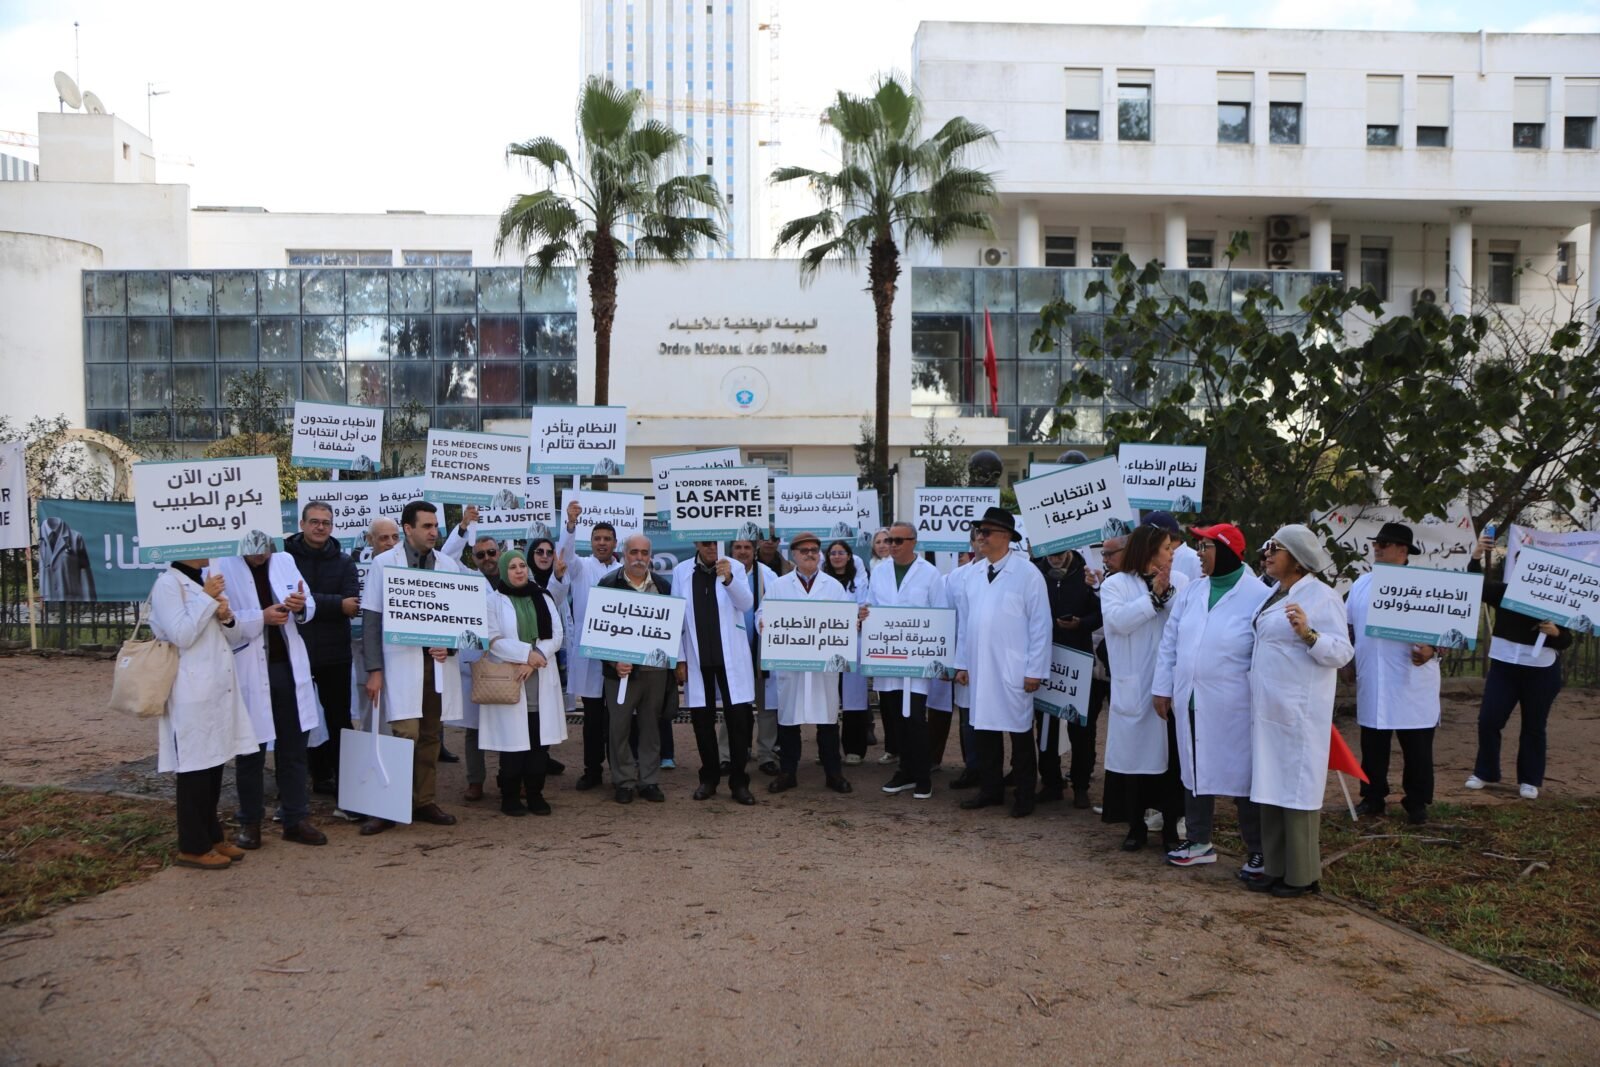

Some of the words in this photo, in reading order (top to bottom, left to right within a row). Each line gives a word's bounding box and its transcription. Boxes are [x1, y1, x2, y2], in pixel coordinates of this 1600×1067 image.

[659, 342, 691, 355] Ordre
[695, 342, 743, 355] National
[300, 416, 340, 424] متحدون
[342, 417, 376, 428] الأطباء
[298, 427, 338, 438] انتخابات
[340, 428, 359, 440] أجل
[576, 422, 616, 438] النظام
[361, 433, 376, 442] من
[578, 438, 616, 450] الصحة
[318, 442, 355, 452] شفافة
[432, 439, 449, 447] LES
[451, 440, 498, 450] MÉDECINS
[500, 444, 522, 452] UNIS
[546, 435, 574, 454] تتألم
[432, 448, 458, 458] POUR
[460, 451, 478, 459] DES
[431, 458, 490, 472] ÉLECTIONS
[1168, 461, 1198, 476] نظام
[168, 468, 202, 490] الآن
[208, 466, 241, 487] الآن
[430, 470, 522, 486] TRANSPARENTES
[526, 476, 540, 485] ES
[676, 479, 712, 487] L'ORDRE
[1098, 478, 1106, 492] لا
[1167, 476, 1196, 491] نظام
[152, 490, 220, 512] الطبيب
[225, 489, 262, 510] يكرم
[344, 493, 368, 502] صوت
[392, 488, 424, 501] شرعية
[676, 490, 698, 503] LA
[704, 486, 760, 502] SANTÉ
[781, 492, 812, 502] قانونية
[815, 491, 852, 501] انتخابات
[946, 495, 996, 504] D'ATTENTE,
[779, 504, 820, 514] دستورية
[822, 502, 854, 514] شرعية
[1102, 496, 1112, 510] لا
[342, 507, 356, 516] حق
[358, 506, 370, 516] حق
[582, 506, 602, 515] يقرر
[604, 506, 634, 516] الأطباء
[676, 504, 762, 519] SOUFFRE!
[857, 508, 870, 518] يكر
[920, 504, 974, 517] PLACE
[1052, 500, 1099, 524] شرعية
[230, 511, 246, 530] او
[335, 518, 372, 529] المغرب
[487, 514, 502, 524] LA
[505, 512, 551, 523] JUSTICE
[620, 517, 638, 529] أيها
[918, 519, 942, 532] AU
[948, 520, 972, 532] VO
[1528, 562, 1569, 578] القانون
[388, 577, 405, 585] LES
[408, 578, 455, 590] MÉDECINS
[458, 584, 479, 592] UNIS
[1521, 572, 1552, 586] تأجيل
[1568, 572, 1600, 587] حترام
[388, 588, 416, 596] POUR
[418, 590, 436, 598] DES
[1380, 584, 1422, 598] يقررون
[1554, 581, 1566, 592] بلا
[1425, 587, 1468, 602] الأطباء
[1530, 590, 1568, 605] ألاعيب
[1569, 586, 1600, 602] واجب
[389, 597, 450, 611] ÉLECTIONS
[1373, 598, 1444, 614] المسؤولون
[1568, 600, 1581, 611] بلا
[602, 602, 670, 621] الانتخابات
[1447, 603, 1472, 619] أيها
[389, 610, 482, 626] TRANSPARENTES
[770, 616, 816, 630] الأطباء،
[884, 618, 920, 629] للتمديد
[922, 619, 930, 628] لا
[588, 618, 633, 636] صوتنا!
[637, 625, 672, 640] حقنا،
[818, 618, 849, 634] نظام
[818, 635, 848, 650] نظام
[868, 629, 902, 644] أصوات
[906, 633, 936, 644] سرقة
[940, 636, 946, 645] و
[866, 644, 888, 656] أحمر
[891, 646, 908, 656] خط
[912, 646, 946, 658] الأطباء
[1050, 662, 1070, 677] انتخ
[1071, 669, 1079, 680] لا
[1040, 679, 1066, 694] شرع
[1068, 686, 1077, 697] لا
